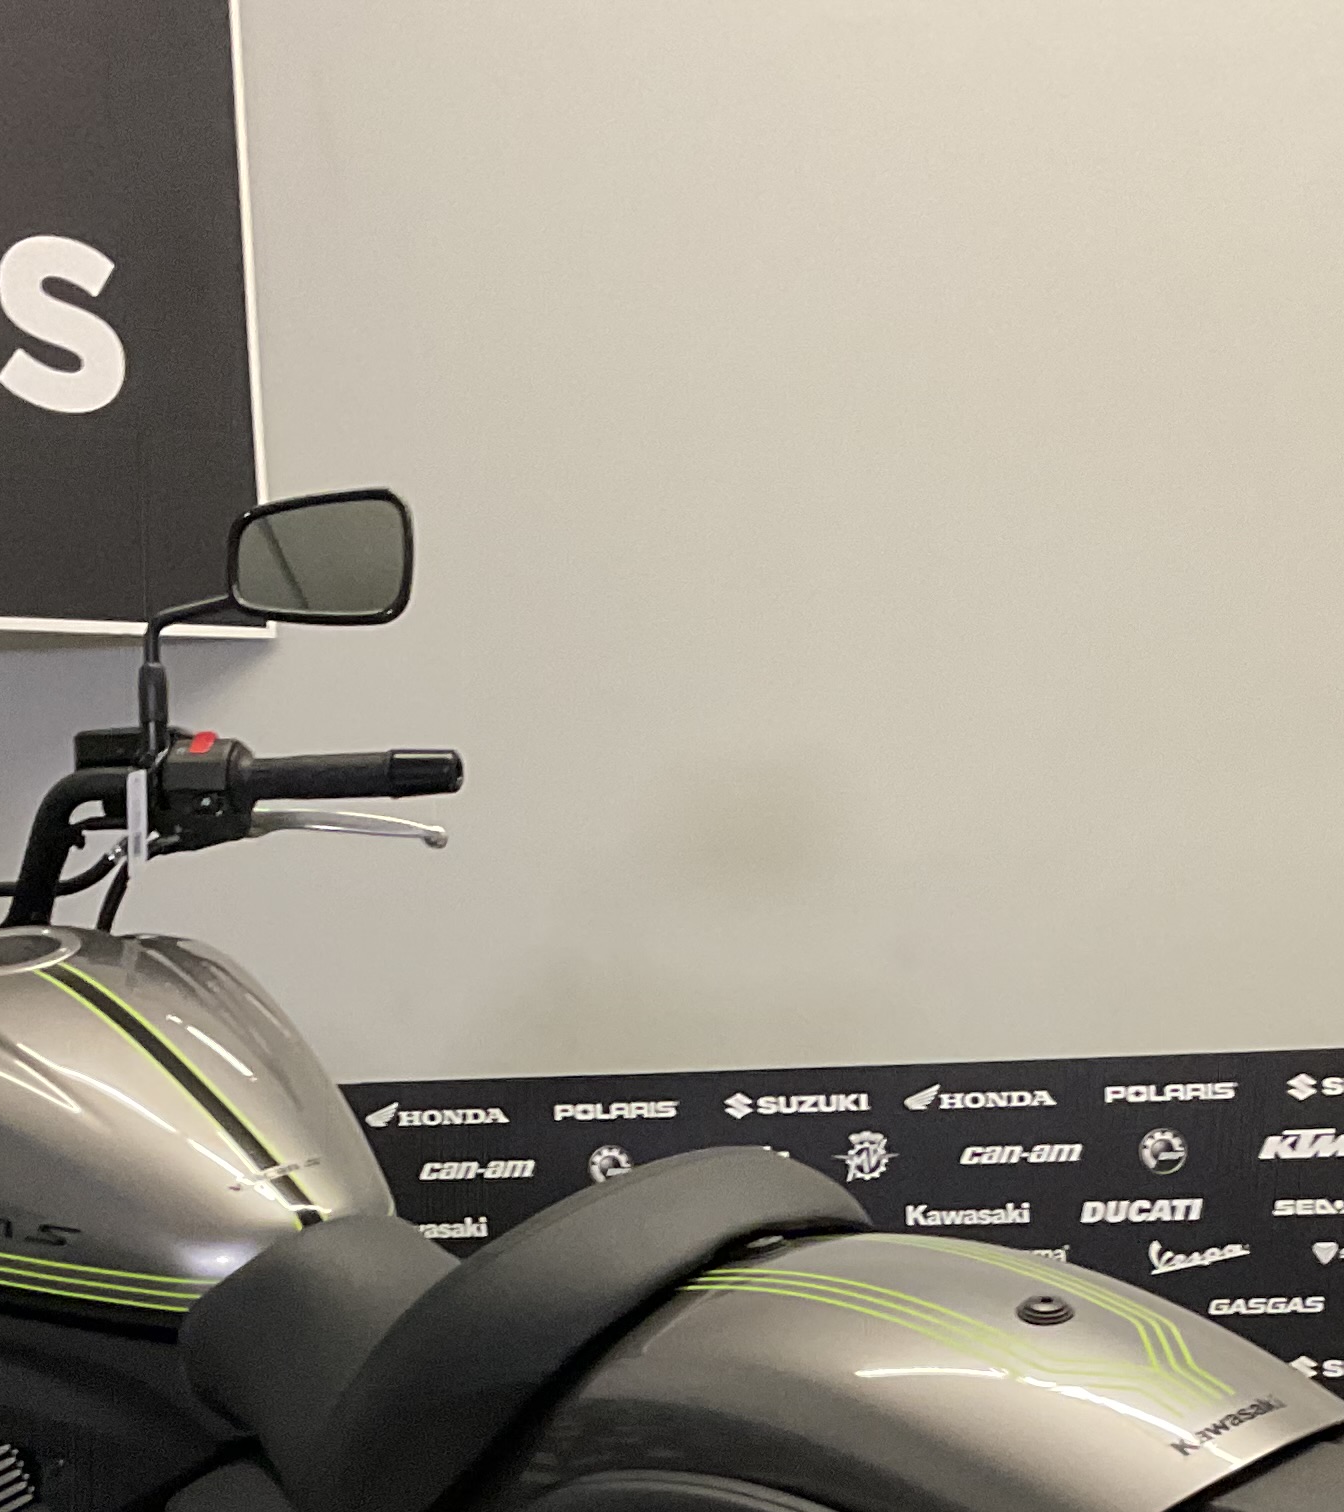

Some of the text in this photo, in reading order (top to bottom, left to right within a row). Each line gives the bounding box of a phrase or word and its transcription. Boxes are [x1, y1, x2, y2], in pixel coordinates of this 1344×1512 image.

[939, 1091, 1057, 1109] HONDA
[1105, 1082, 1238, 1103] POLARIS
[554, 1101, 678, 1121] POLARIS
[757, 1094, 870, 1114] SUZUKI
[398, 1108, 509, 1126] HONDA
[960, 1144, 1082, 1164] can-am
[420, 1160, 535, 1180] can-am
[906, 1203, 1030, 1225] Kawasaki
[1080, 1199, 1203, 1223] DUCATI
[24, 1223, 82, 1246] S
[419, 1216, 488, 1238] asaki
[1149, 1241, 1250, 1274] Vespa
[1209, 1297, 1325, 1315] GASGAS
